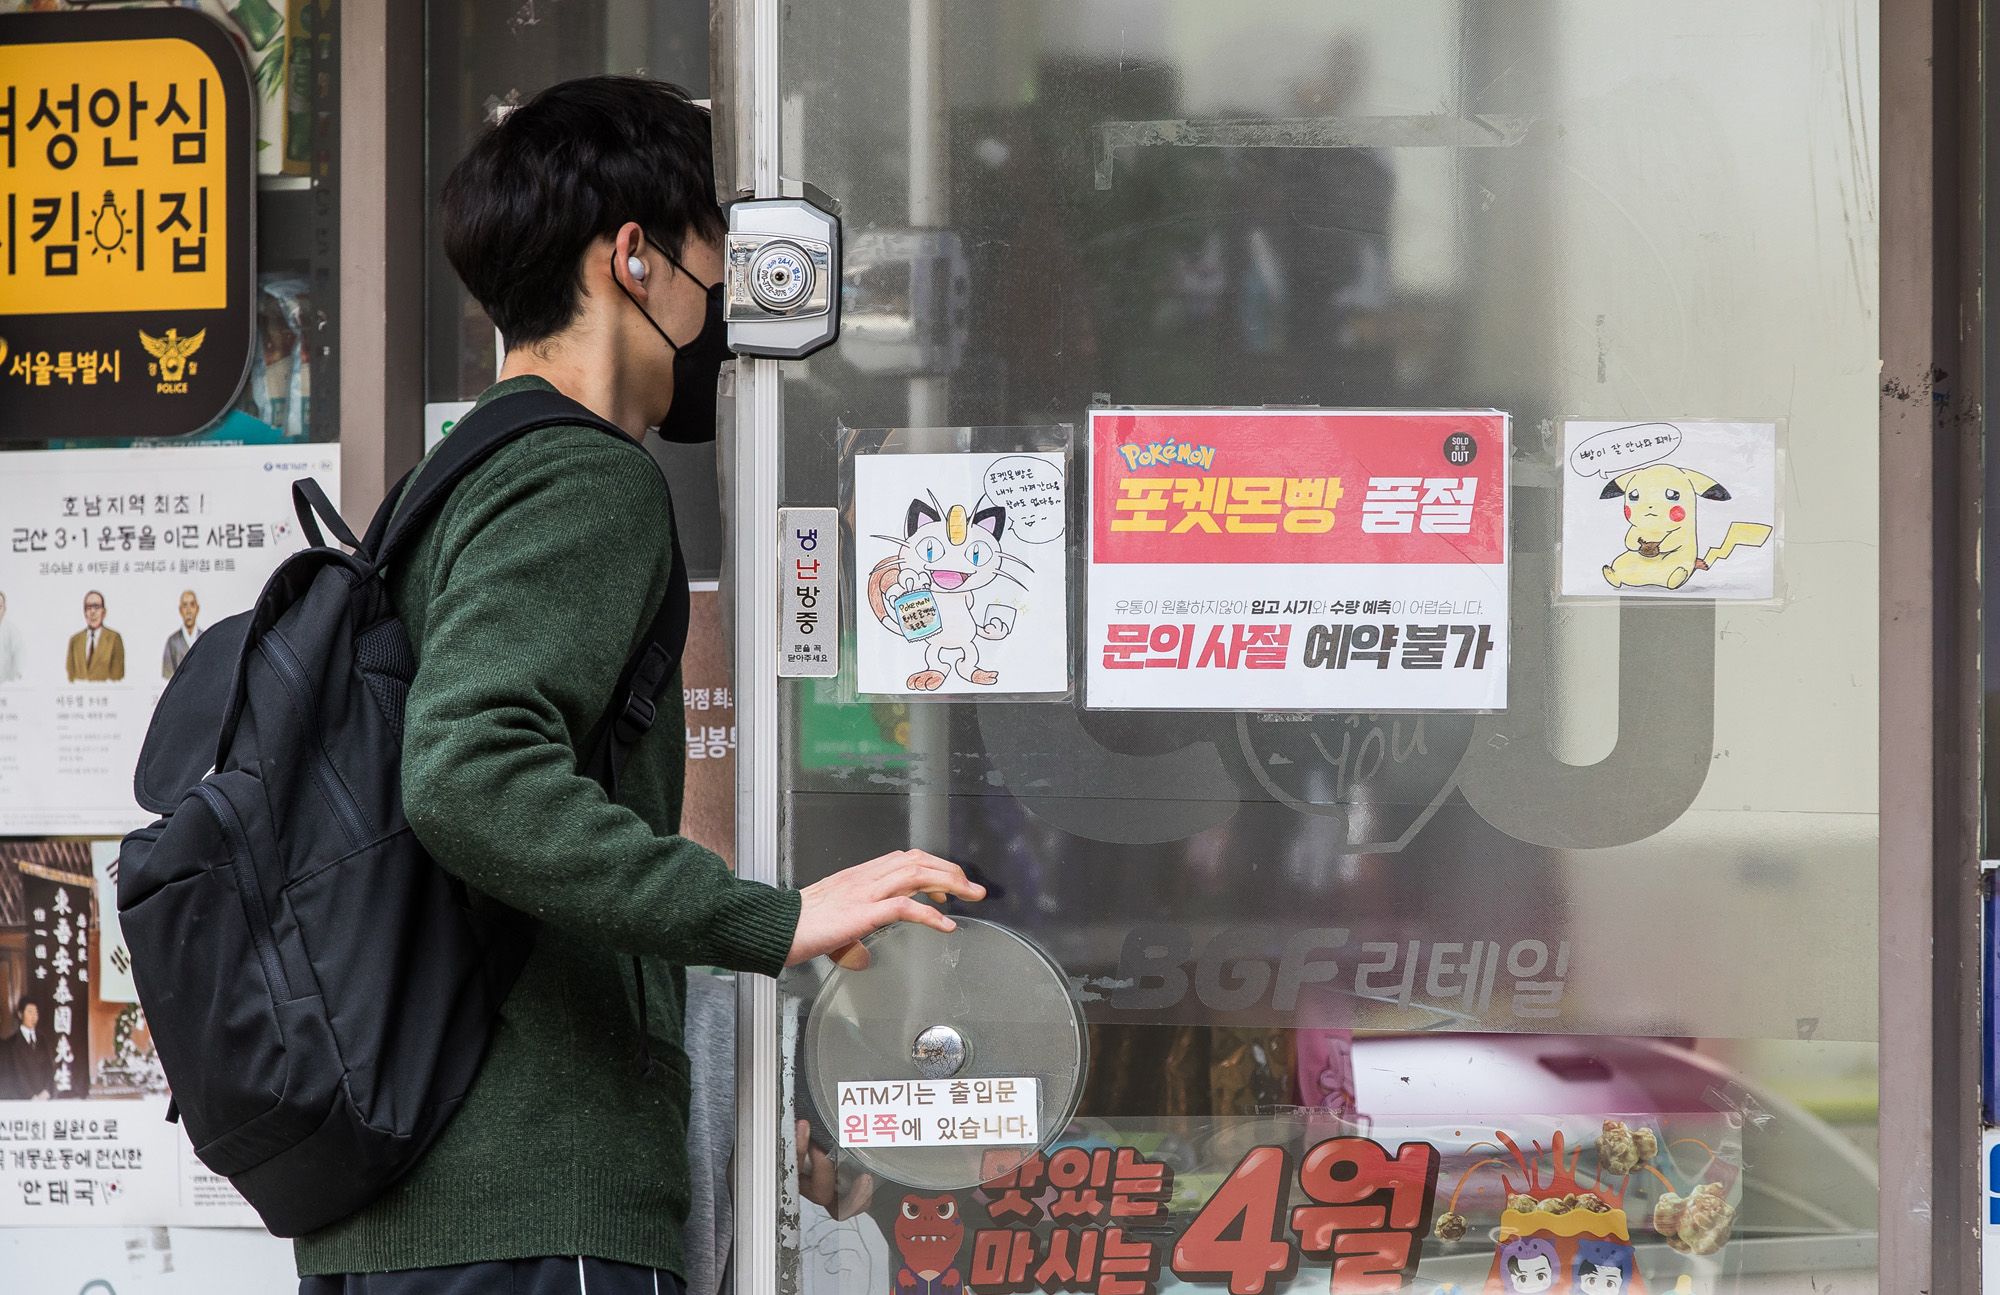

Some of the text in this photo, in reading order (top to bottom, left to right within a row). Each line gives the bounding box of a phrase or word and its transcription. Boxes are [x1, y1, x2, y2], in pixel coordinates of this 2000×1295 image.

[10, 350, 120, 386] 서울특별시
[157, 382, 188, 394] POLICE
[1452, 437, 1469, 446] SOLD
[1579, 447, 1606, 461] 빵이
[1611, 442, 1622, 455] 잘
[1451, 451, 1470, 462] OUT
[990, 468, 1034, 484] 포켓몬빵은
[995, 487, 1014, 496] 내가
[1005, 499, 1026, 510] 찾아도
[1110, 477, 1479, 534] 포켓몬빵 품절
[12, 527, 47, 553] 군산
[97, 525, 156, 552] 운동을
[164, 524, 200, 549] 이끈
[206, 522, 266, 549] 사람들
[1114, 600, 1484, 615] 유통이 원활하지않아 입고 시기와 수량 예측이 어렵습니다.
[794, 644, 822, 653] 문을 꼭
[1102, 624, 1495, 669] 문의 사절 예약 불가
[787, 654, 828, 663] 닫아주세요
[841, 1079, 1018, 1107] ATM기는 출입문
[53, 1119, 119, 1141] 일원으로
[843, 1113, 1033, 1143] 왼쪽에 있습니다.
[96, 1148, 143, 1170] 헌신한
[980, 1146, 1168, 1219] 맛있는
[969, 1226, 1156, 1295] 마시는
